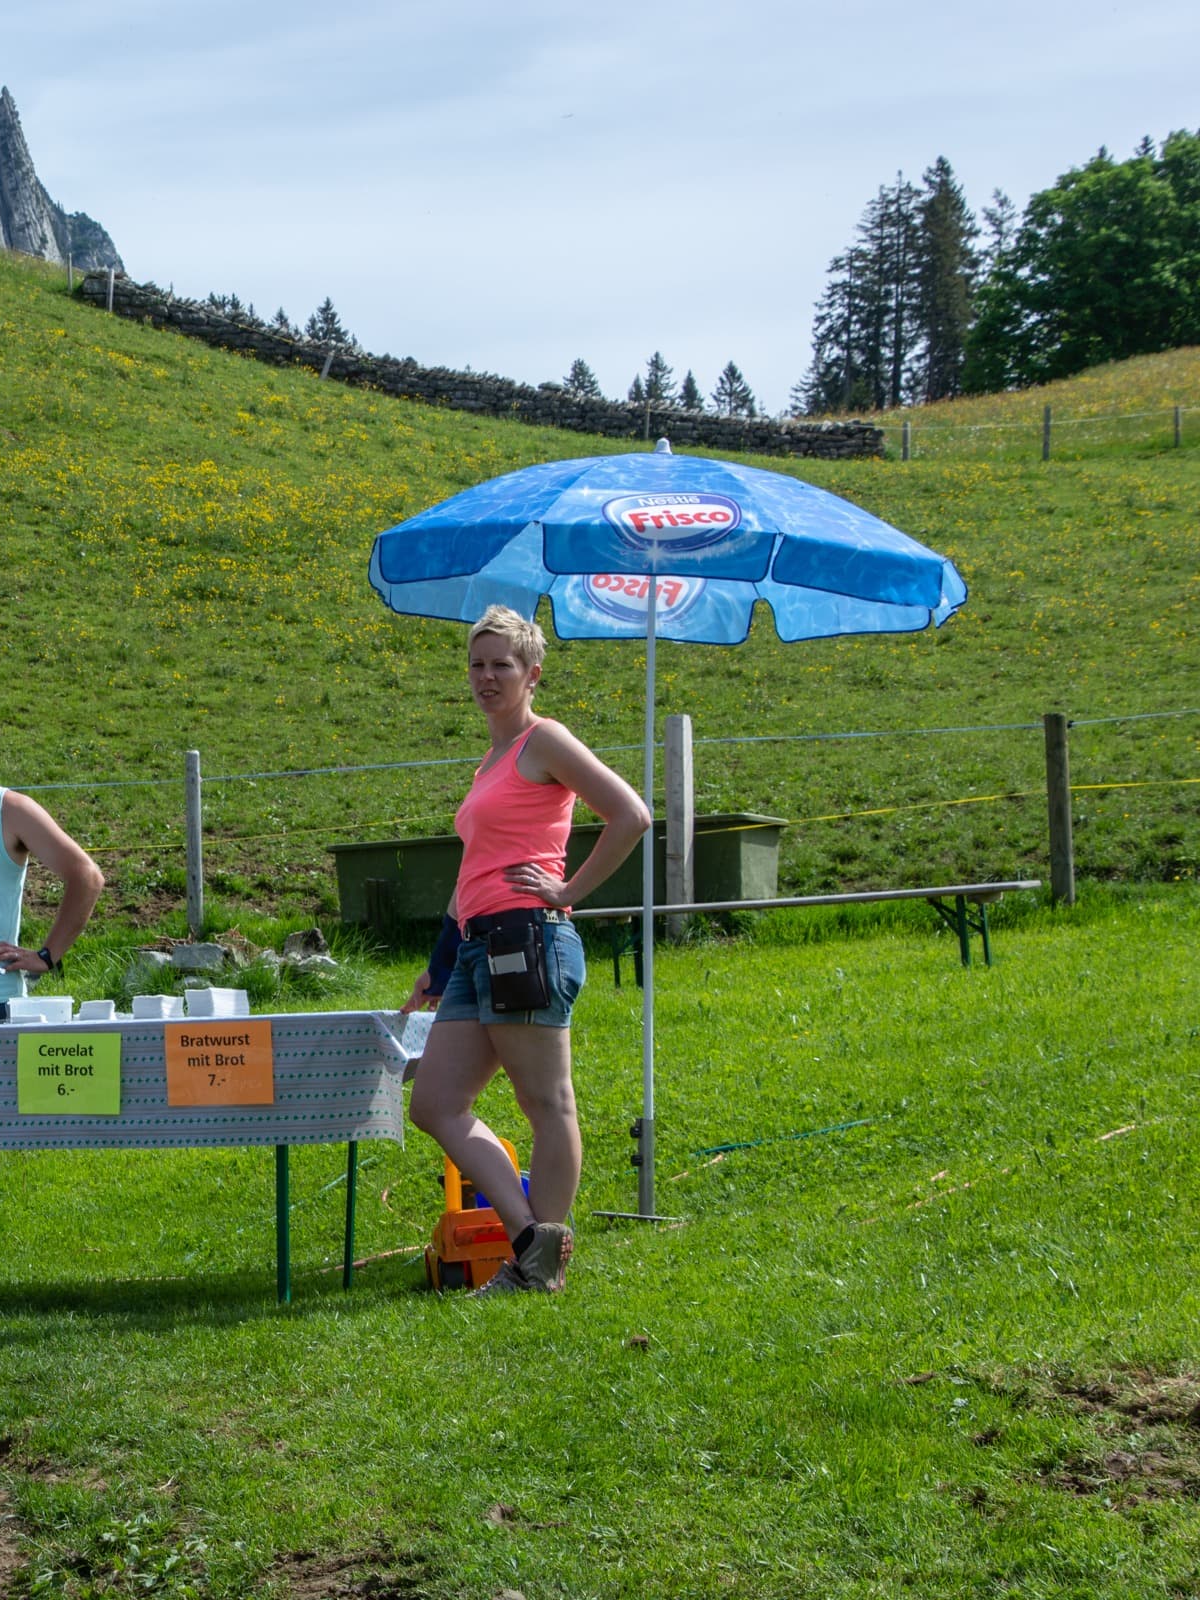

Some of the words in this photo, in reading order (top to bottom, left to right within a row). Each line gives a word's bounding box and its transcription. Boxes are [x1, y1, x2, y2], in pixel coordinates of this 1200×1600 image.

[628, 510, 731, 533] Frisco
[180, 1033, 250, 1047] Bratwurst
[38, 1043, 94, 1057] Cervelat
[187, 1053, 211, 1067] mit
[215, 1053, 245, 1067] Brot
[38, 1064, 61, 1076] mit
[64, 1064, 94, 1076] Brot
[208, 1074, 226, 1086] 7.-
[57, 1083, 76, 1096] 6.-
